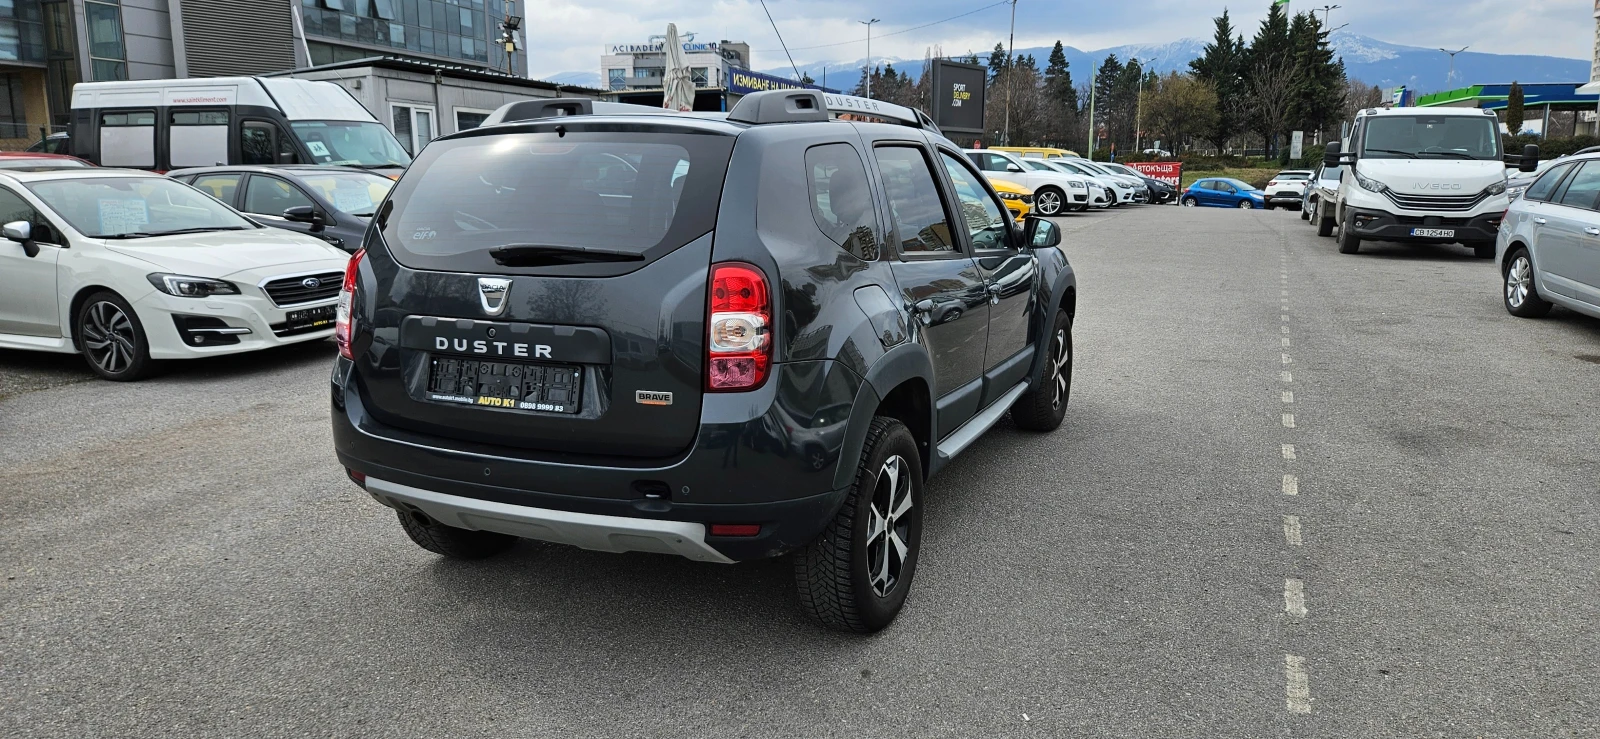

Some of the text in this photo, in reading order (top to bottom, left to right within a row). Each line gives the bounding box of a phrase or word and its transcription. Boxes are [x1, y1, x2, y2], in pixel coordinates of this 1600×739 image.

[612, 44, 661, 53] ACIBADEM
[733, 72, 770, 91] ИЗМИВАНЕ
[953, 83, 966, 91] SPORT
[827, 96, 880, 112] DUSTER
[1132, 163, 1173, 174] Автокъща
[1413, 182, 1462, 190] IVECO
[435, 336, 553, 359] DUSTER
[478, 396, 502, 406] AUTO
[503, 398, 515, 407] K1
[639, 393, 671, 401] BRAVE
